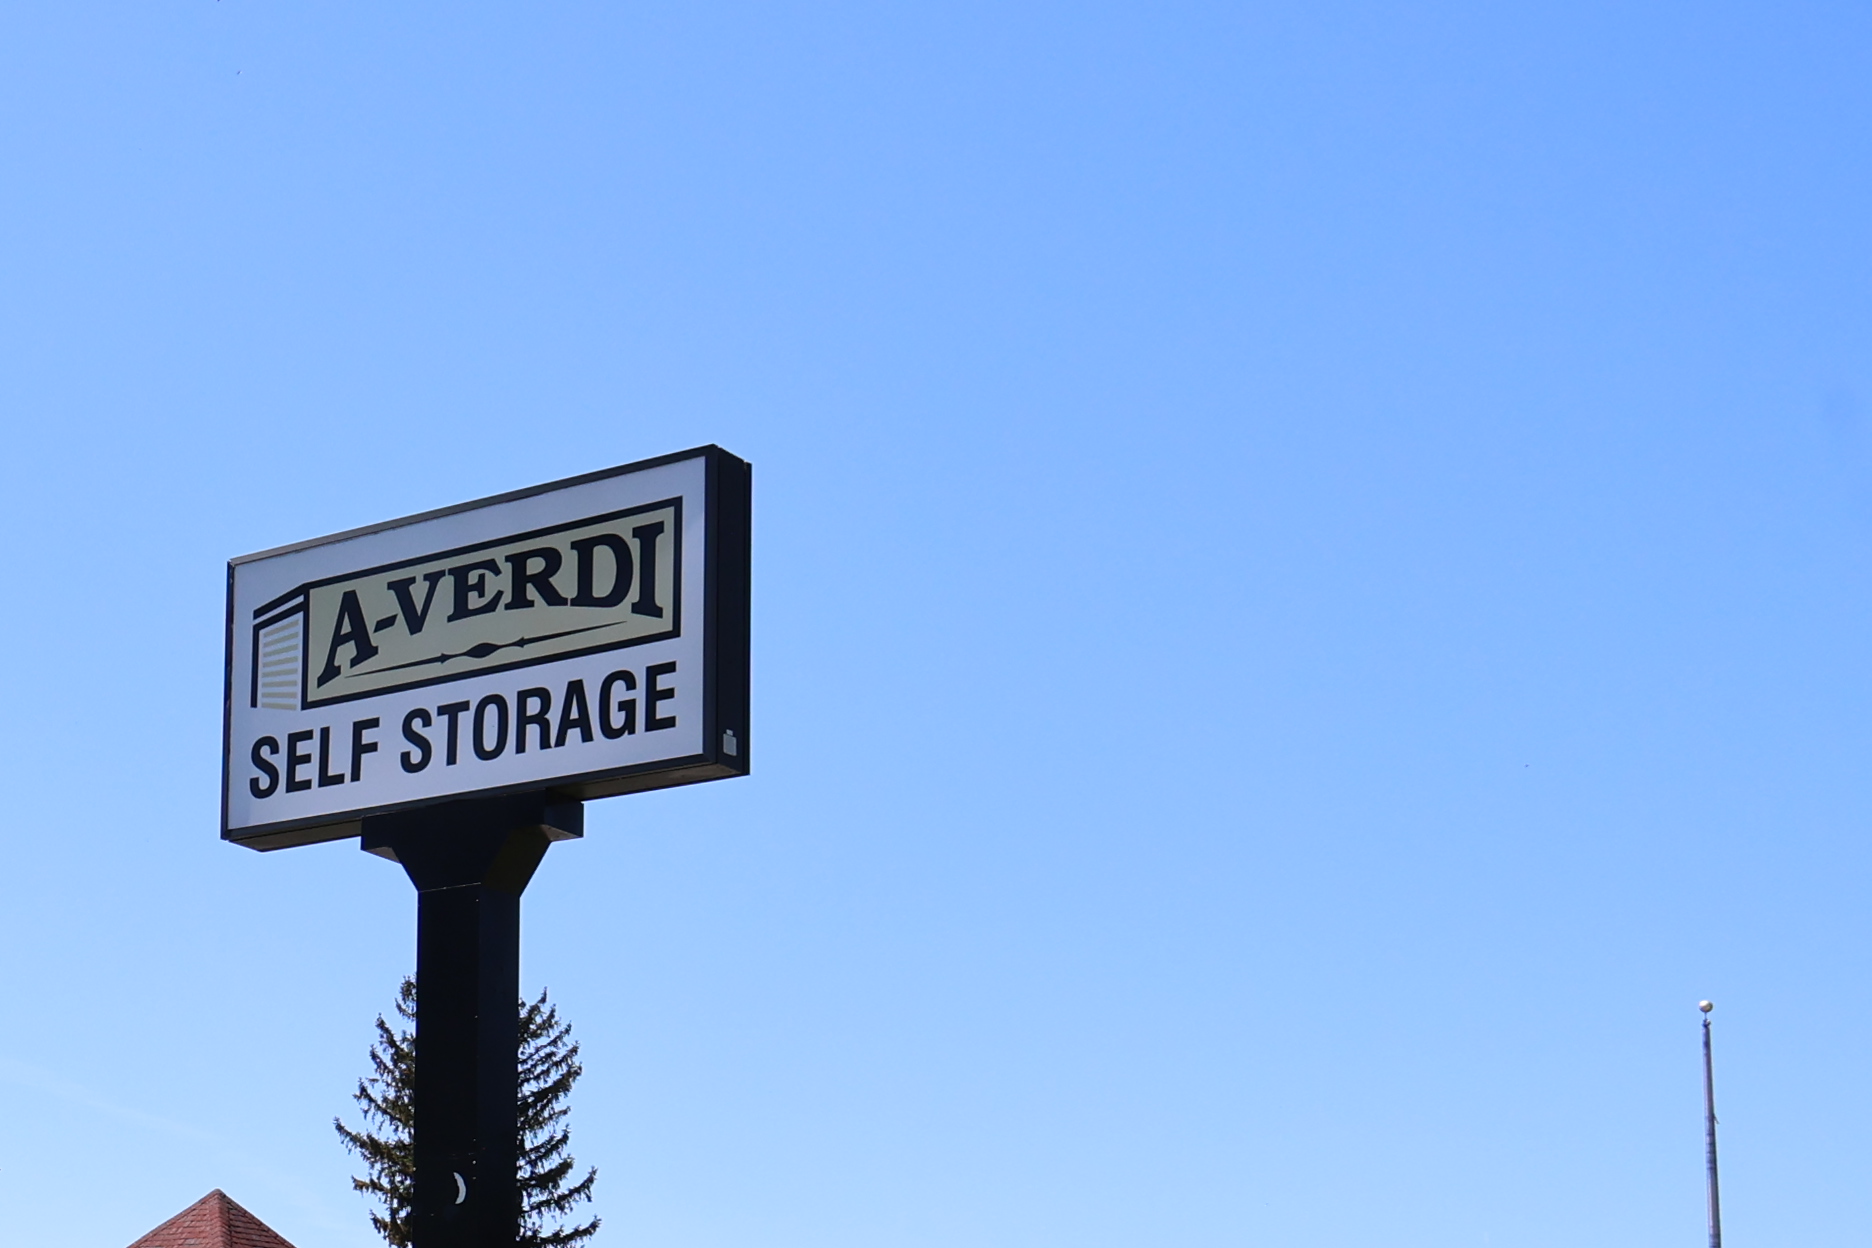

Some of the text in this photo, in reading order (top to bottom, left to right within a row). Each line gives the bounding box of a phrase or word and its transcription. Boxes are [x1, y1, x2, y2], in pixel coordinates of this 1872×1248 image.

[316, 520, 665, 689] A-VERDI
[249, 660, 677, 800] SELF STORAGE
